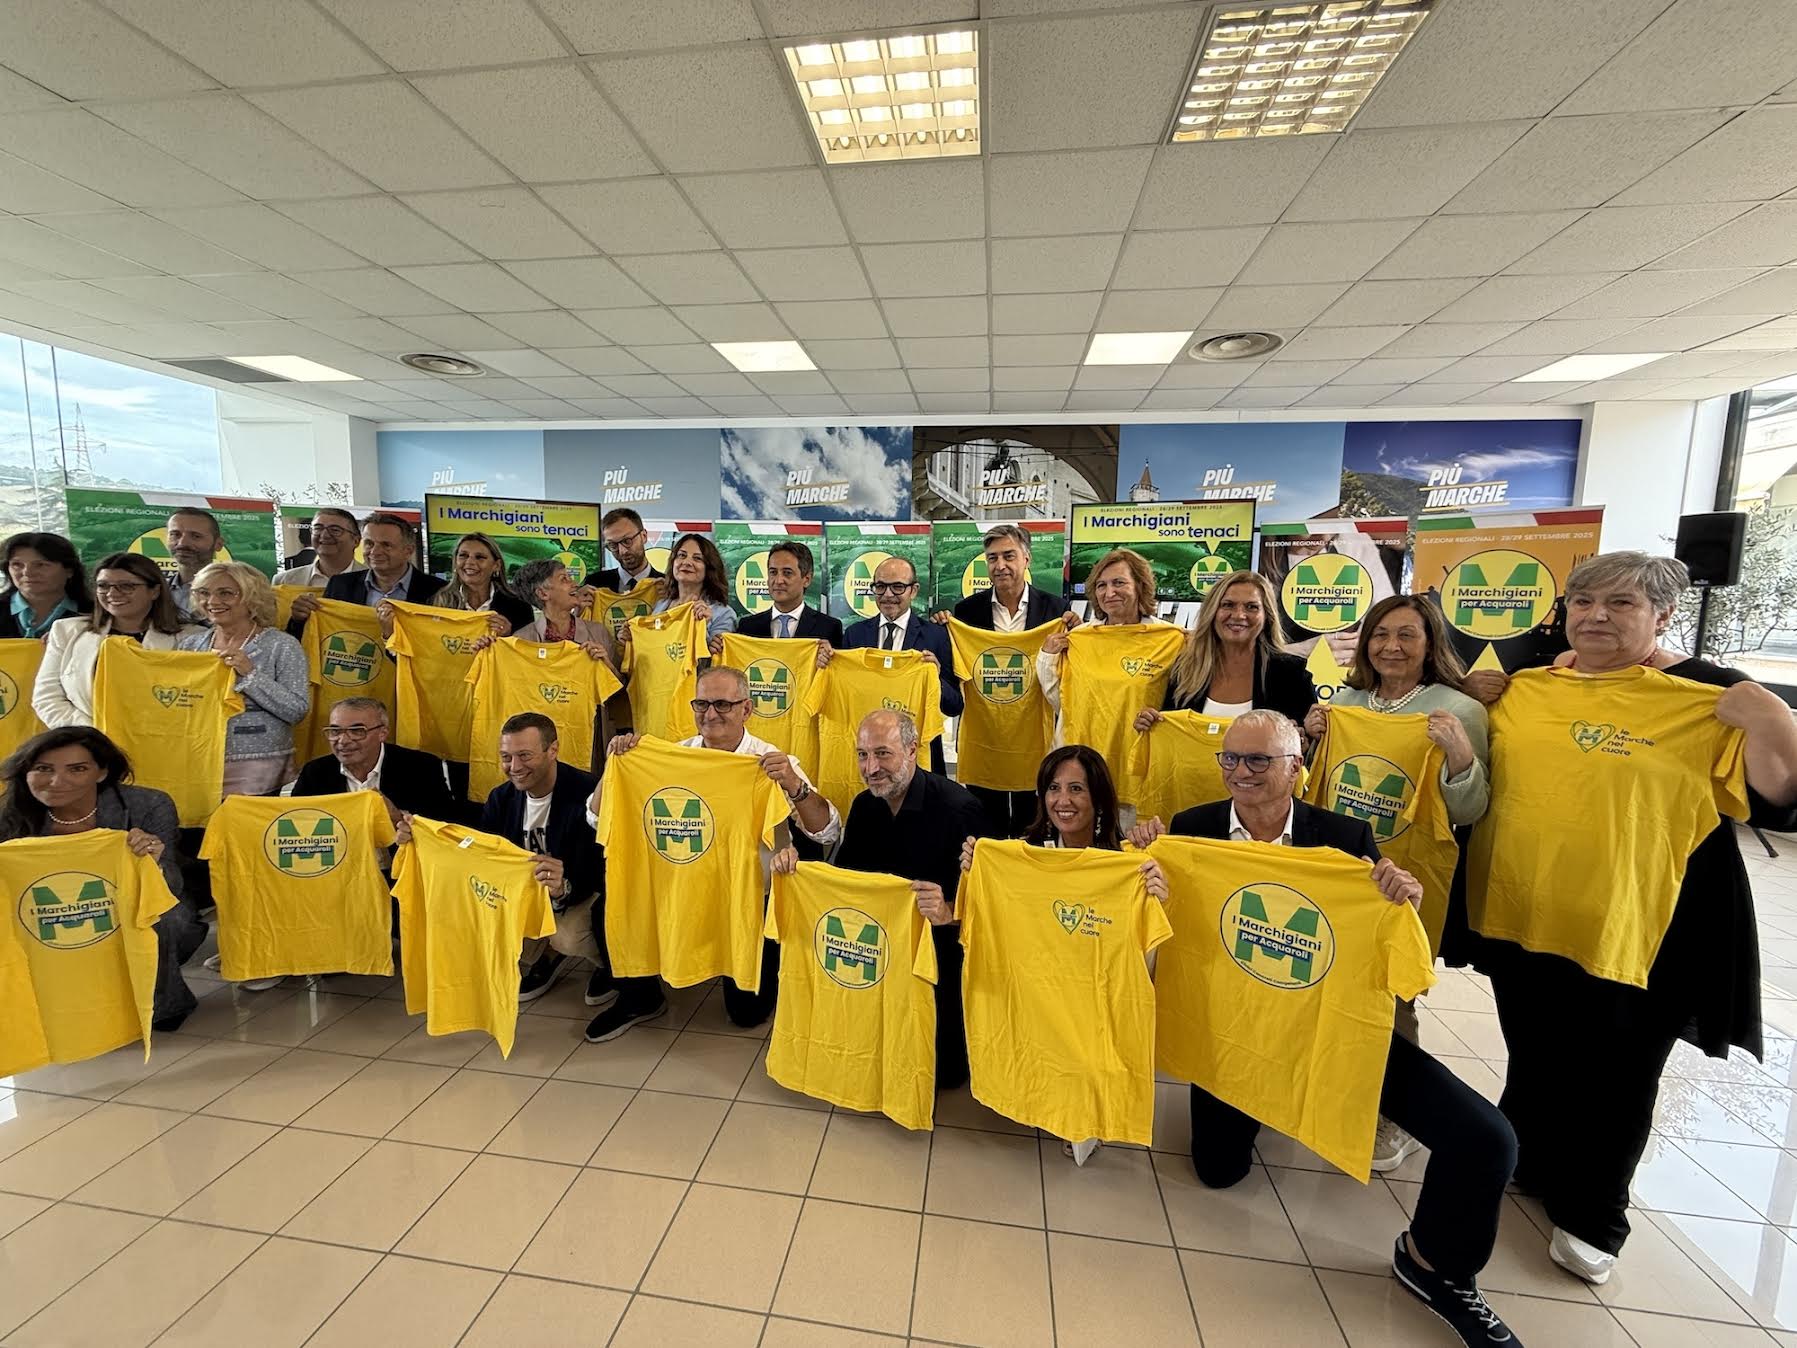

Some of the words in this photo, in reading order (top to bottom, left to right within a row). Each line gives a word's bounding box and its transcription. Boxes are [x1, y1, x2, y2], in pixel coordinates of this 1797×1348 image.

[432, 466, 455, 485] PIÙ
[604, 466, 628, 486] PIÙ
[786, 466, 814, 487] PIÙ
[981, 464, 1007, 486] PIÙ
[1203, 464, 1234, 486] PIÙ
[1428, 464, 1462, 486] PIÙ
[604, 484, 662, 504] MARCHE
[786, 484, 850, 504] MARCHE
[978, 484, 1046, 505] MARCHE
[1426, 484, 1508, 508] MARCHE
[440, 507, 443, 518] I
[448, 508, 544, 525] Marchigiani
[1084, 516, 1087, 527] I
[1091, 513, 1190, 530] Marchigiani
[543, 524, 588, 536] tenaci
[1188, 524, 1239, 537] tenaci
[1296, 586, 1363, 598] Marchigiani
[1458, 588, 1542, 599] Marchigiani
[1313, 597, 1353, 605] Acquaroli
[1480, 600, 1529, 608] Acquaroli
[328, 651, 376, 664] Marchigiani
[750, 683, 790, 692] Marchigiani
[1614, 734, 1655, 746] Marche
[1601, 747, 1631, 756] cuore
[1339, 785, 1406, 809] Marchigiani
[1352, 800, 1393, 817] Acquaroli
[655, 818, 705, 830] Marchigiani
[279, 836, 338, 847] Marchigiani
[37, 898, 114, 915] Marchigiani
[1086, 914, 1112, 925] Marche
[1232, 915, 1236, 924] I
[1239, 918, 1322, 951] Marchigiani
[826, 937, 882, 956] Marchigiani
[1241, 932, 1258, 943] per
[1260, 936, 1308, 959] Acquaroli
